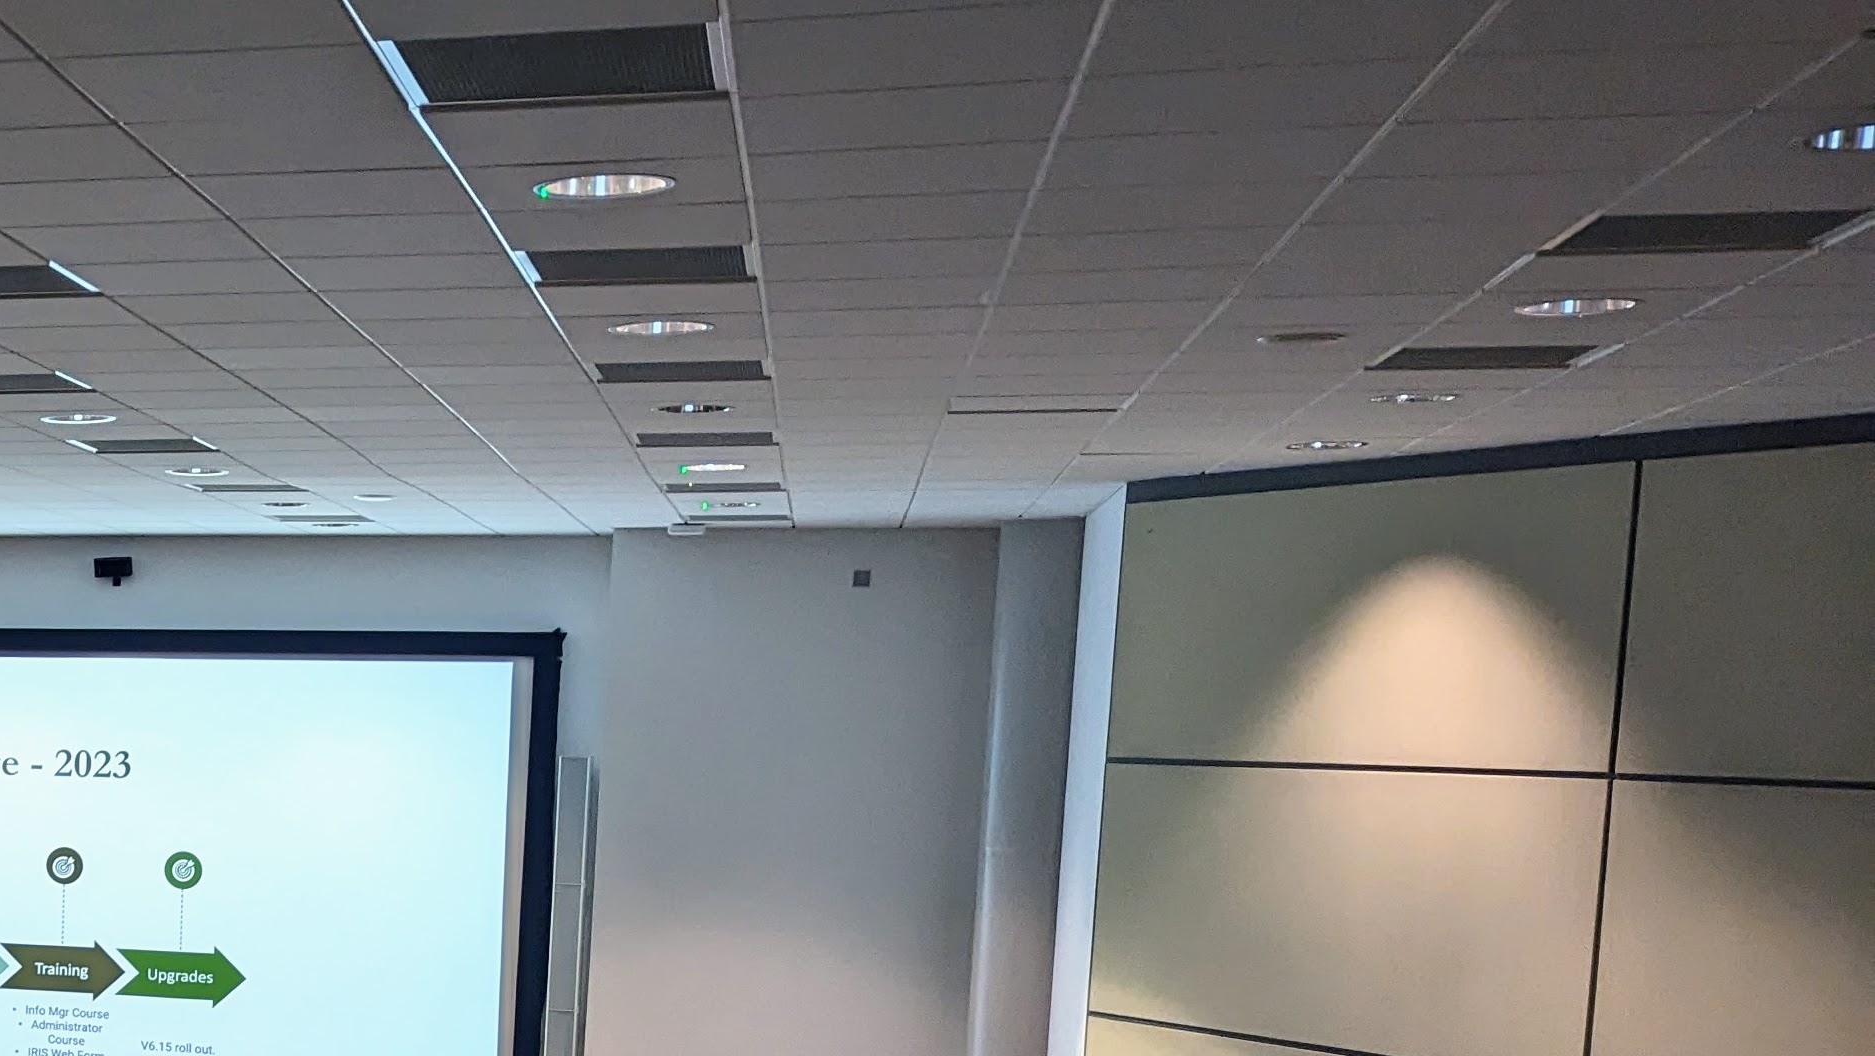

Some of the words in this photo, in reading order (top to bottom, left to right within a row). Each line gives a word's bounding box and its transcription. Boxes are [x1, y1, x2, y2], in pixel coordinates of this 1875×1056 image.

[54, 749, 132, 779] 2023
[34, 961, 89, 980] Training
[147, 967, 214, 985] Upgrades
[25, 1004, 46, 1016] Info
[48, 1006, 70, 1019] Mgr
[72, 1008, 110, 1019] Course
[31, 1020, 103, 1033] Administrator
[47, 1034, 85, 1046] Course
[140, 1040, 172, 1052] V6.15
[174, 1042, 192, 1053] roll
[194, 1045, 216, 1055] out.
